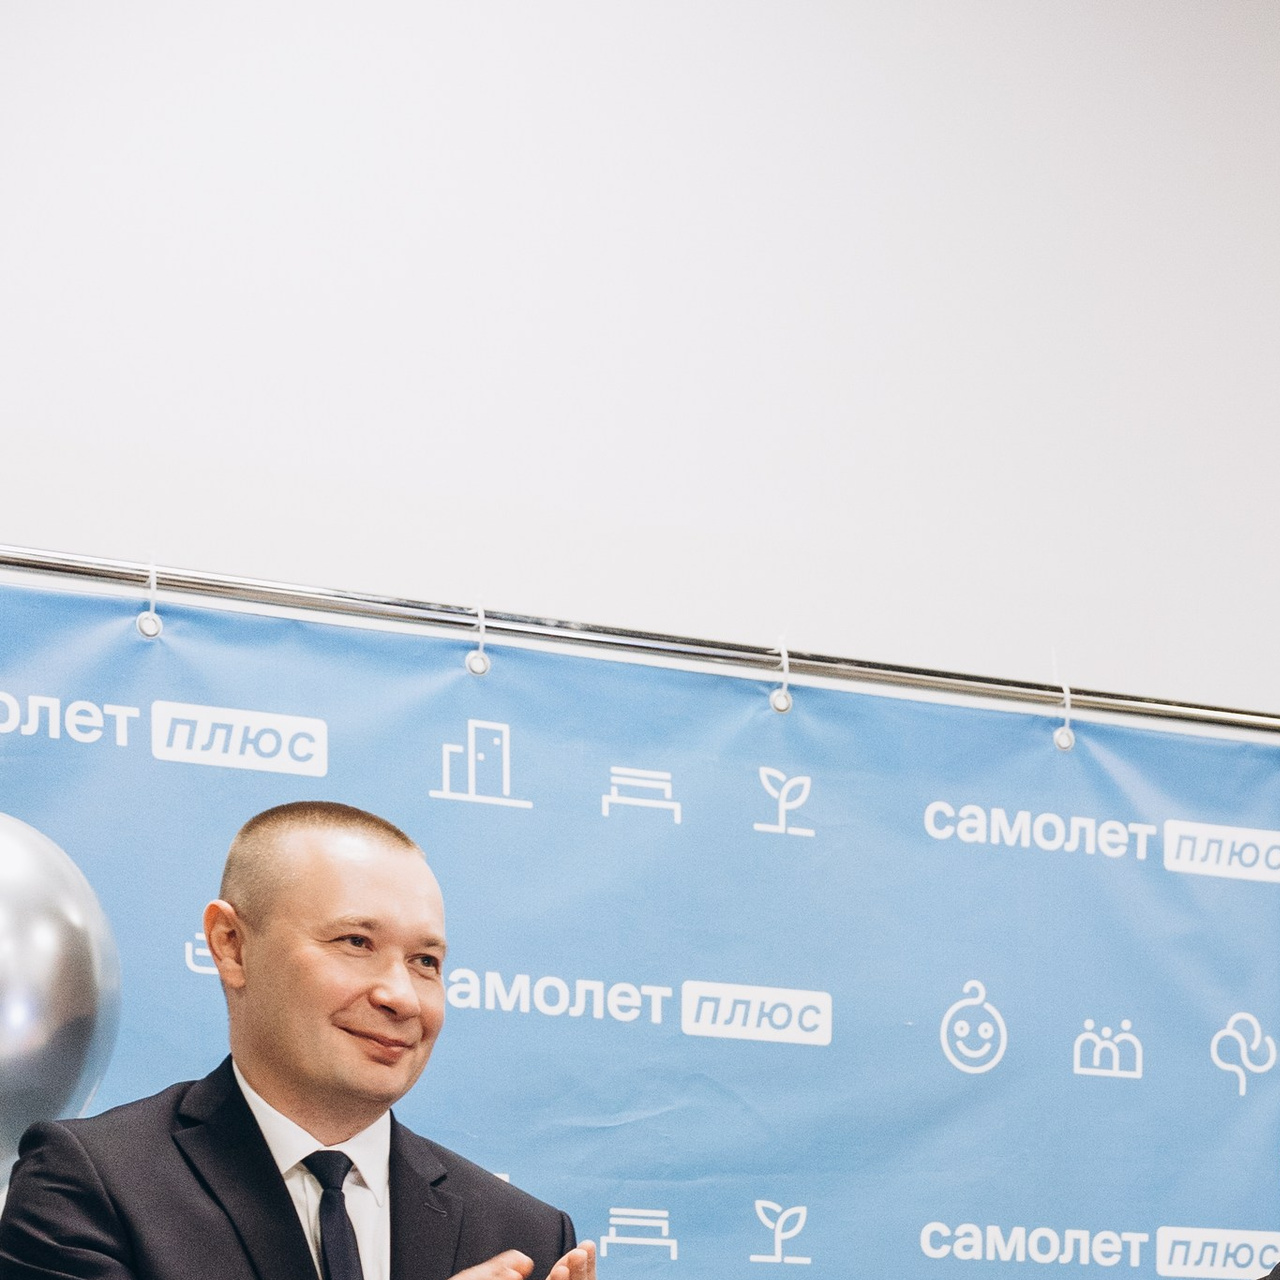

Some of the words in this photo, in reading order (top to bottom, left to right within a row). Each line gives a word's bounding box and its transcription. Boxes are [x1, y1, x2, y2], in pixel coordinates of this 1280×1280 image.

[923, 799, 1158, 861] самолет
[446, 967, 673, 1025] амолет
[919, 1220, 1150, 1268] самолет
